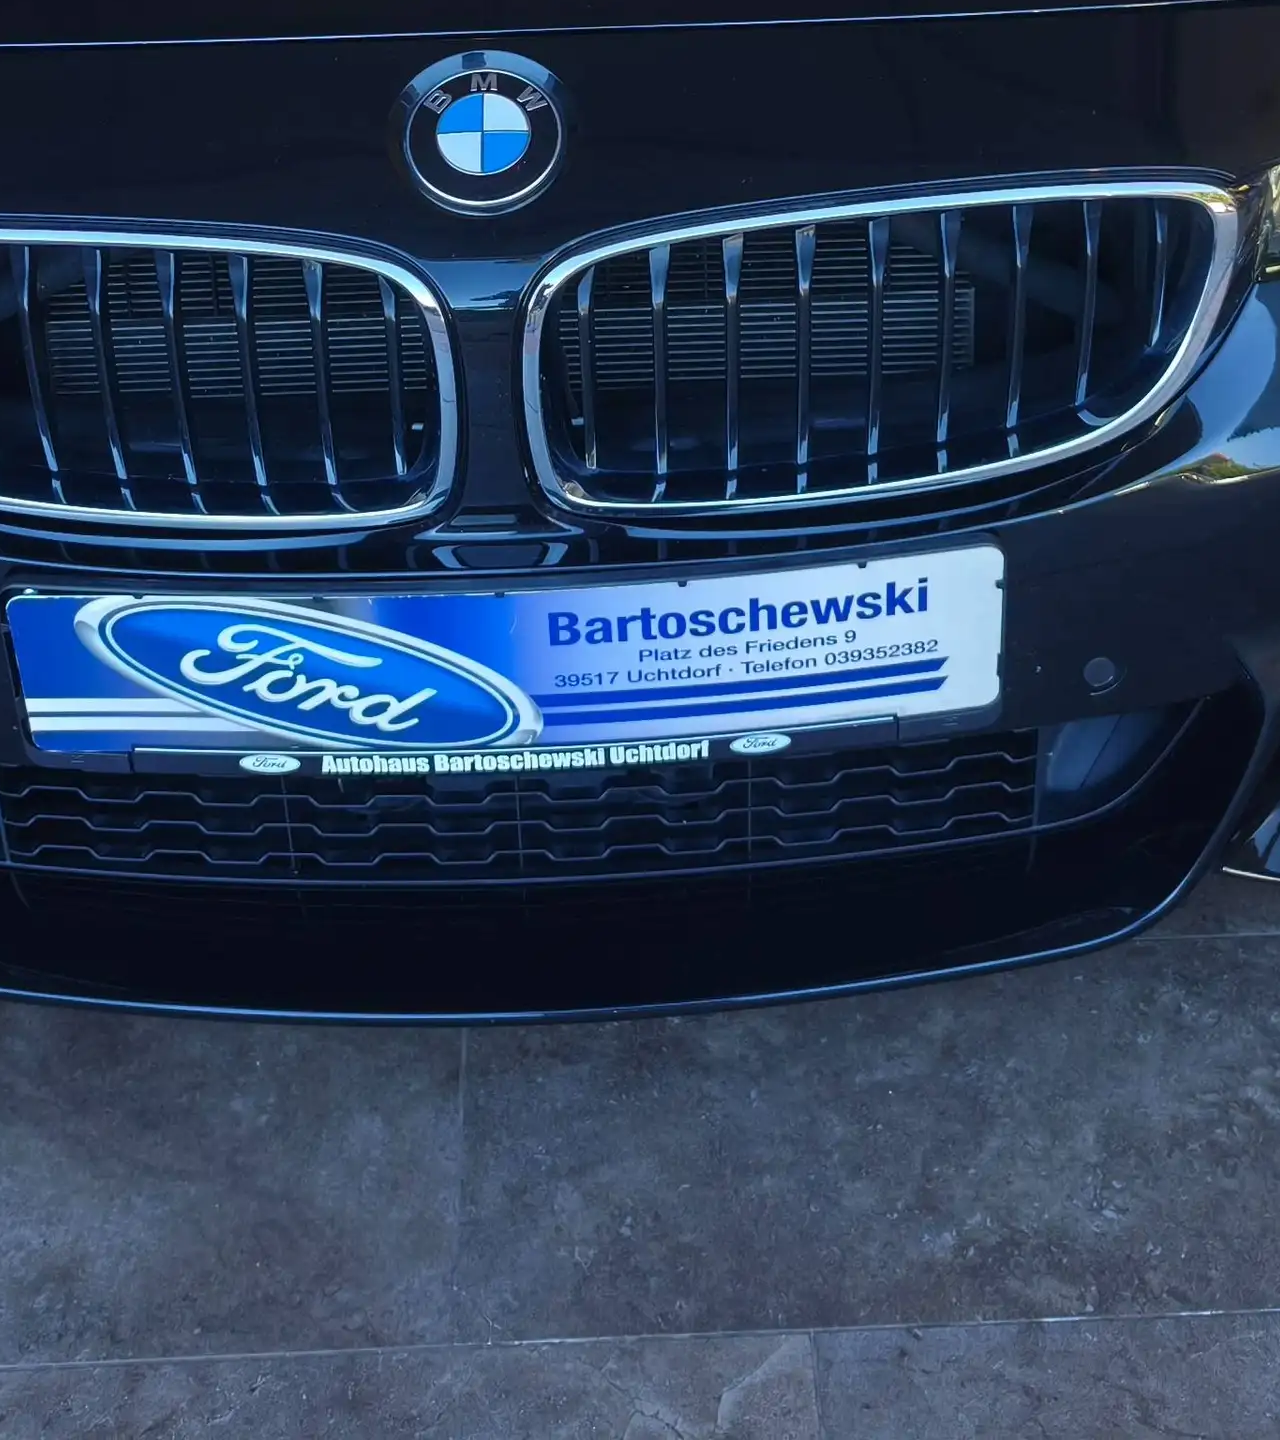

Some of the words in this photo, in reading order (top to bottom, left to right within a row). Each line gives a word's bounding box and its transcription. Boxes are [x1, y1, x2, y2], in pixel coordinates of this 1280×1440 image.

[424, 73, 548, 114] BMW
[548, 577, 928, 646] Bartoschewski
[554, 671, 619, 687] 39517
[627, 663, 722, 683] Uchtdorf
[740, 656, 818, 674] Telefon
[824, 639, 939, 666] 039352382
[639, 647, 692, 662] Platz
[698, 645, 738, 658] des
[745, 634, 838, 654] Friedens
[844, 630, 857, 643] 9
[179, 623, 438, 732] Ford
[322, 755, 430, 775] Autohaus
[433, 747, 604, 774] Bartoschewski
[610, 739, 710, 765] Uchtdorf
